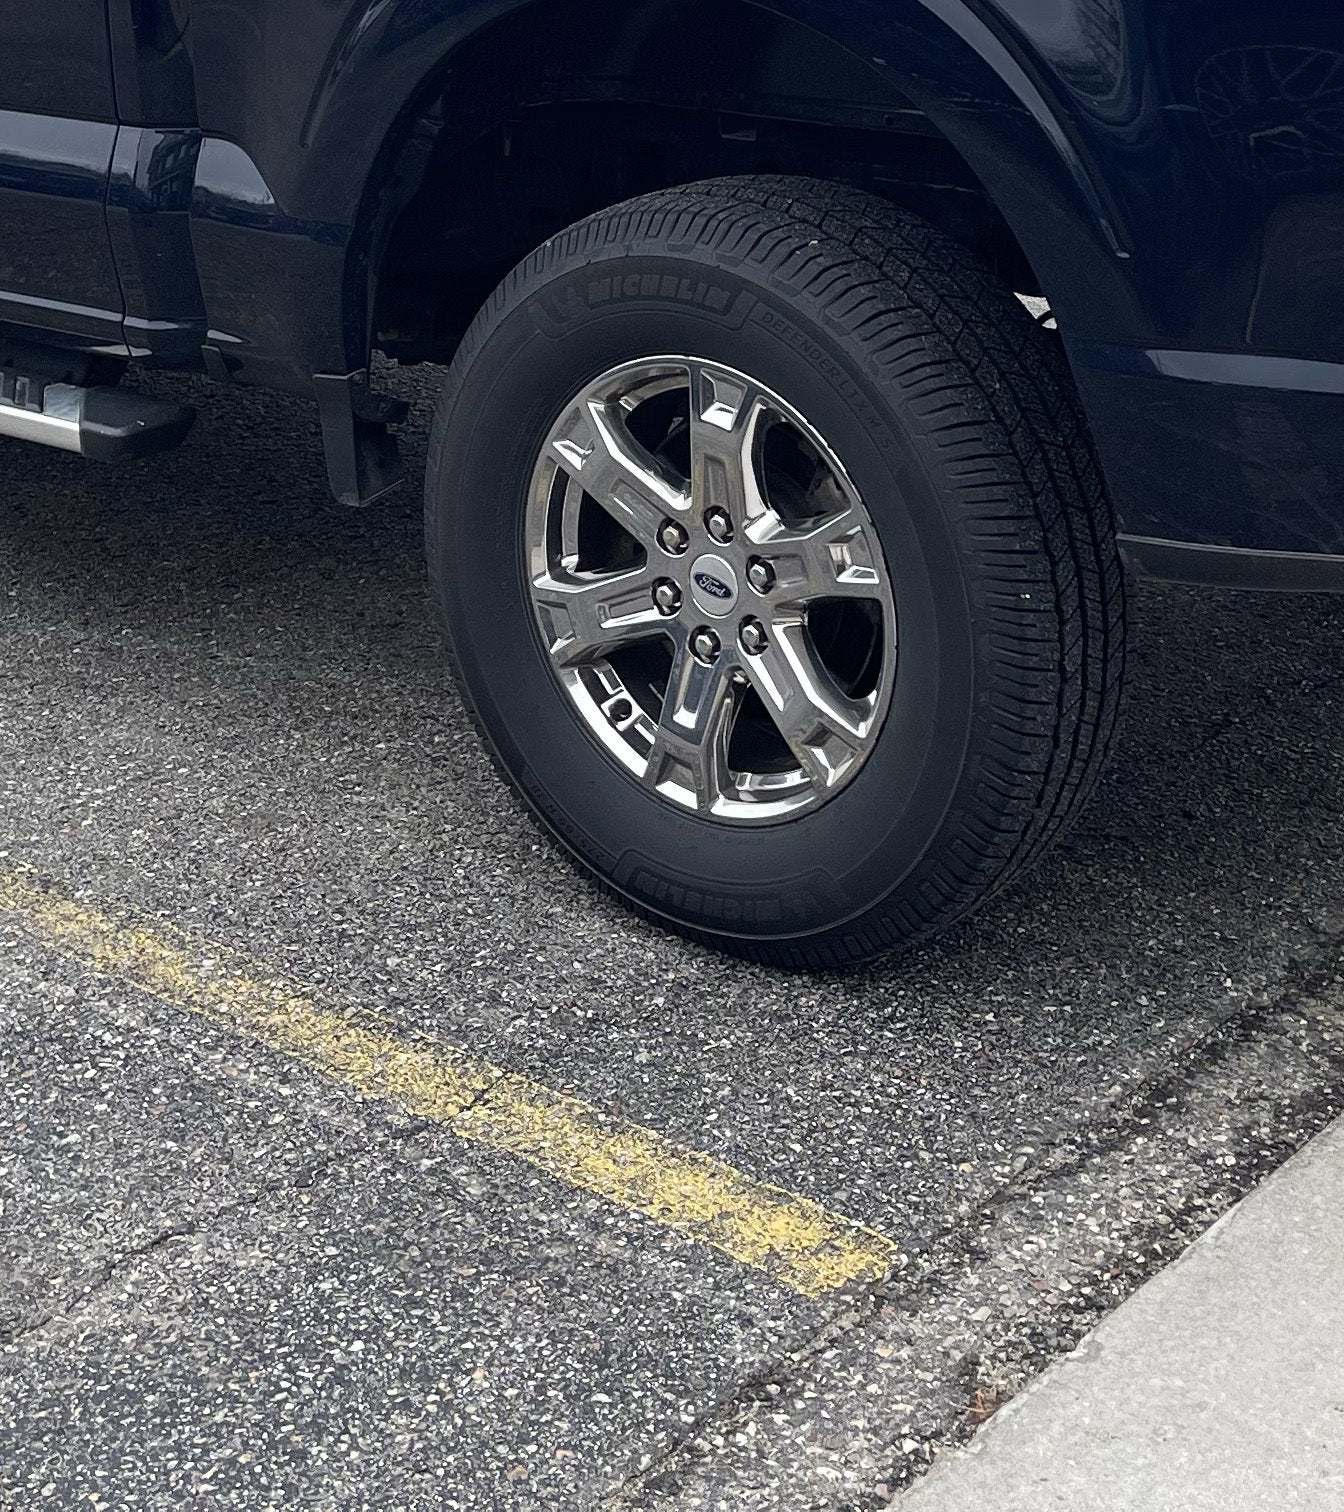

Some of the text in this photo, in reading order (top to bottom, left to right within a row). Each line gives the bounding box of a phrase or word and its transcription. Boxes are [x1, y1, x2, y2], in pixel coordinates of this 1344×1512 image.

[586, 273, 732, 311] MICHELIN
[760, 310, 842, 379] DEFENDER
[698, 575, 727, 597] Ford
